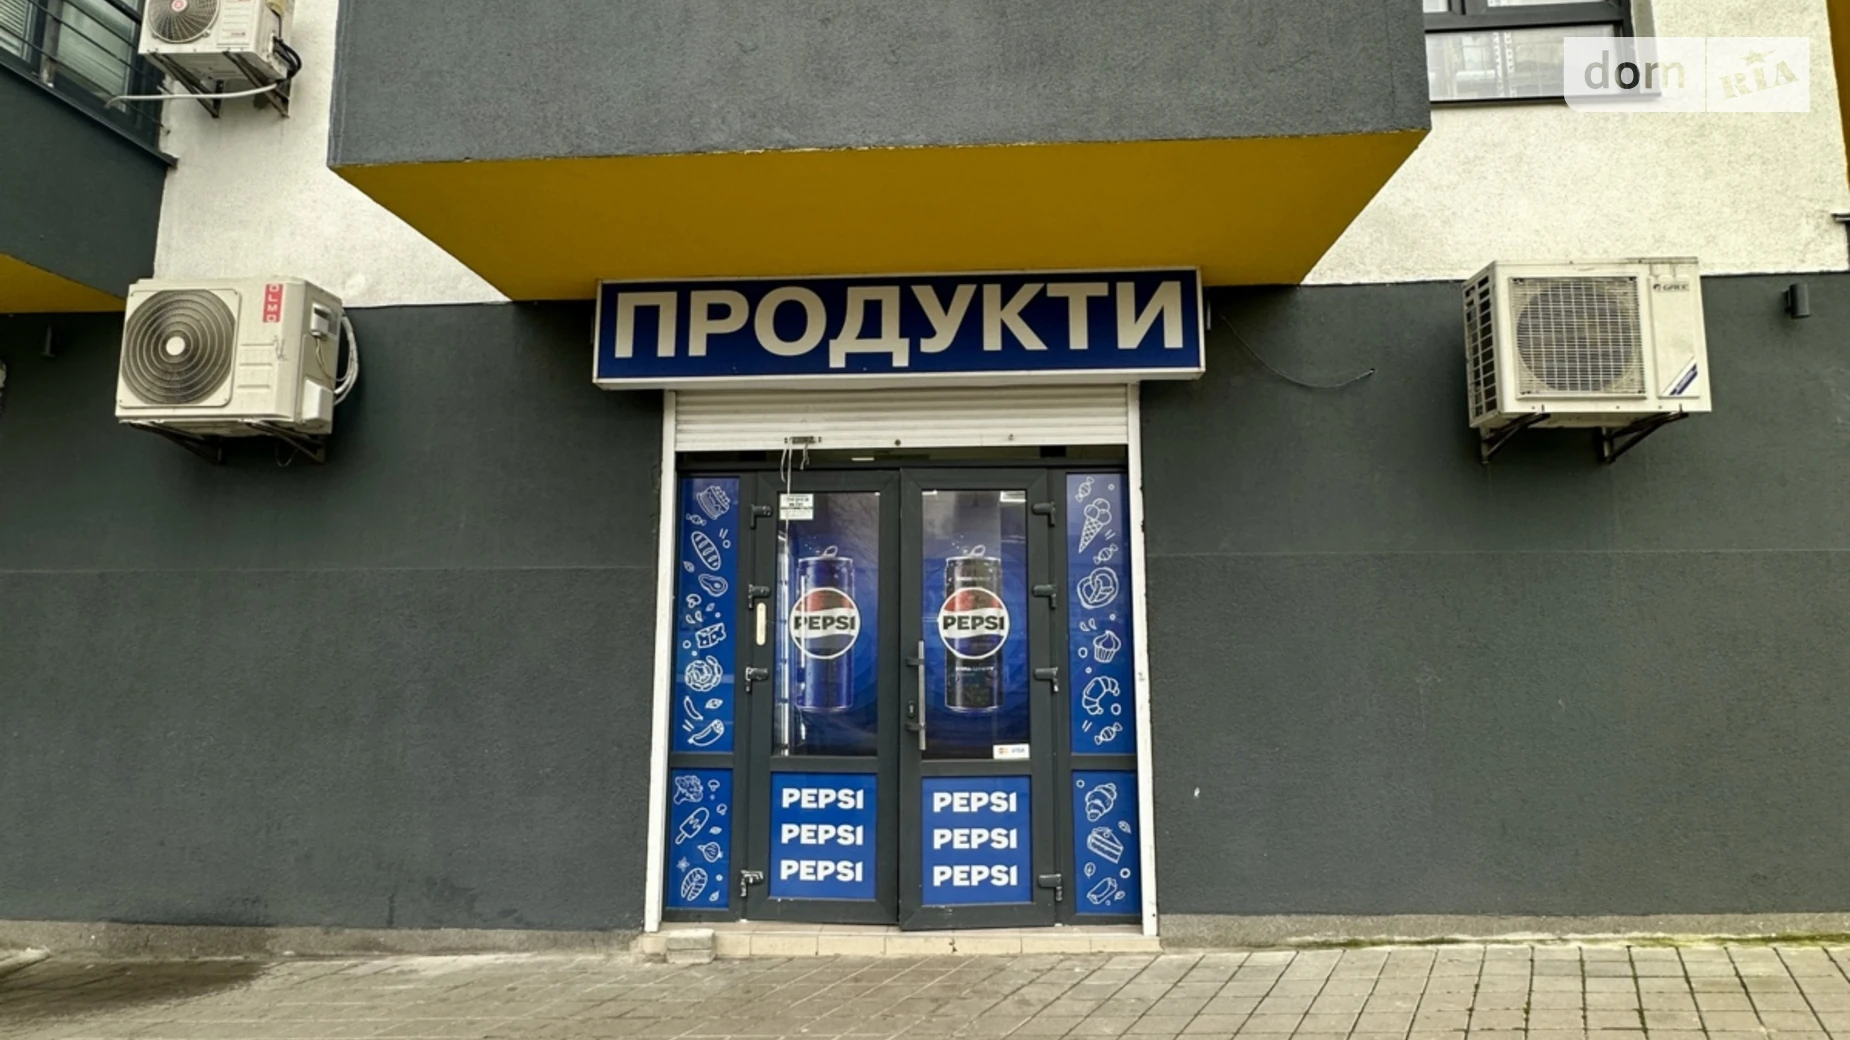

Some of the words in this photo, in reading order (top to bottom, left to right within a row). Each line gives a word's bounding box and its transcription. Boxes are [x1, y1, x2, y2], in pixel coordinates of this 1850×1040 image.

[266, 284, 280, 323] OLMO
[614, 280, 1184, 369] ПРОДУКТИ
[794, 615, 856, 630] PEPSI
[943, 615, 1005, 630] PEPSI
[782, 788, 864, 810] PEPSI
[933, 791, 1017, 813] PEPSI
[781, 823, 864, 846] PEPSI
[933, 827, 1018, 850] PEPSI
[780, 859, 863, 882] PEPSI
[933, 864, 1018, 887] PEPSI
